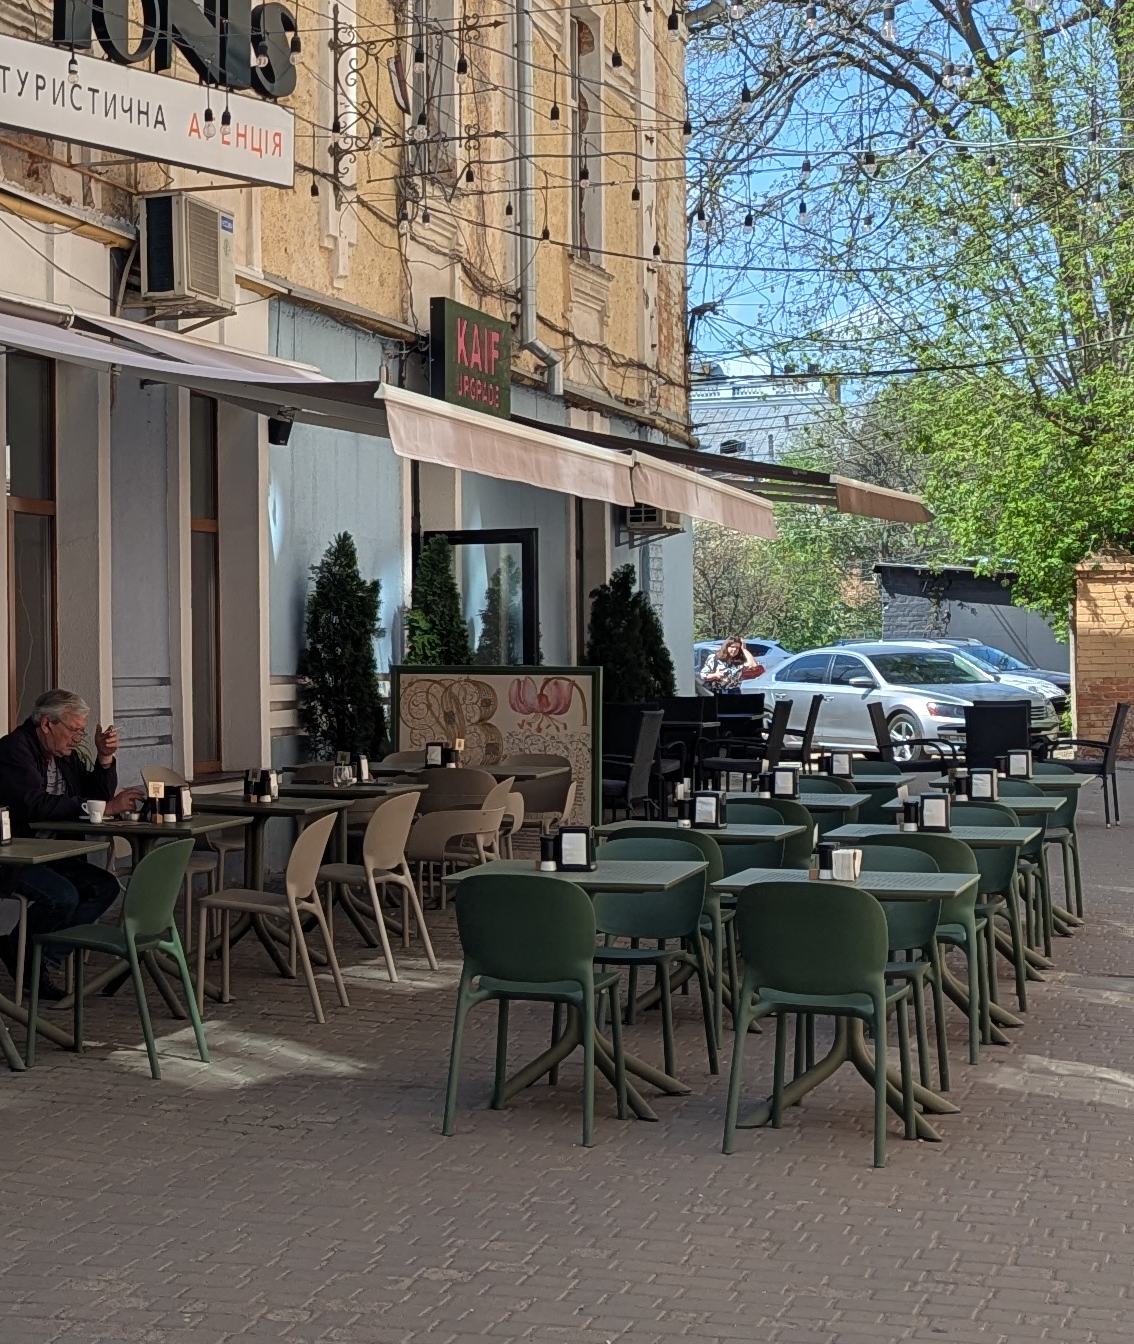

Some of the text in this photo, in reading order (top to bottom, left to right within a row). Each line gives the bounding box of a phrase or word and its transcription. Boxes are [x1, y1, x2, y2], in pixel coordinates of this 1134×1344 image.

[187, 111, 283, 159] АЕНЦІЯ
[456, 317, 500, 376] KAIF
[456, 372, 500, 409] UPGRADE
